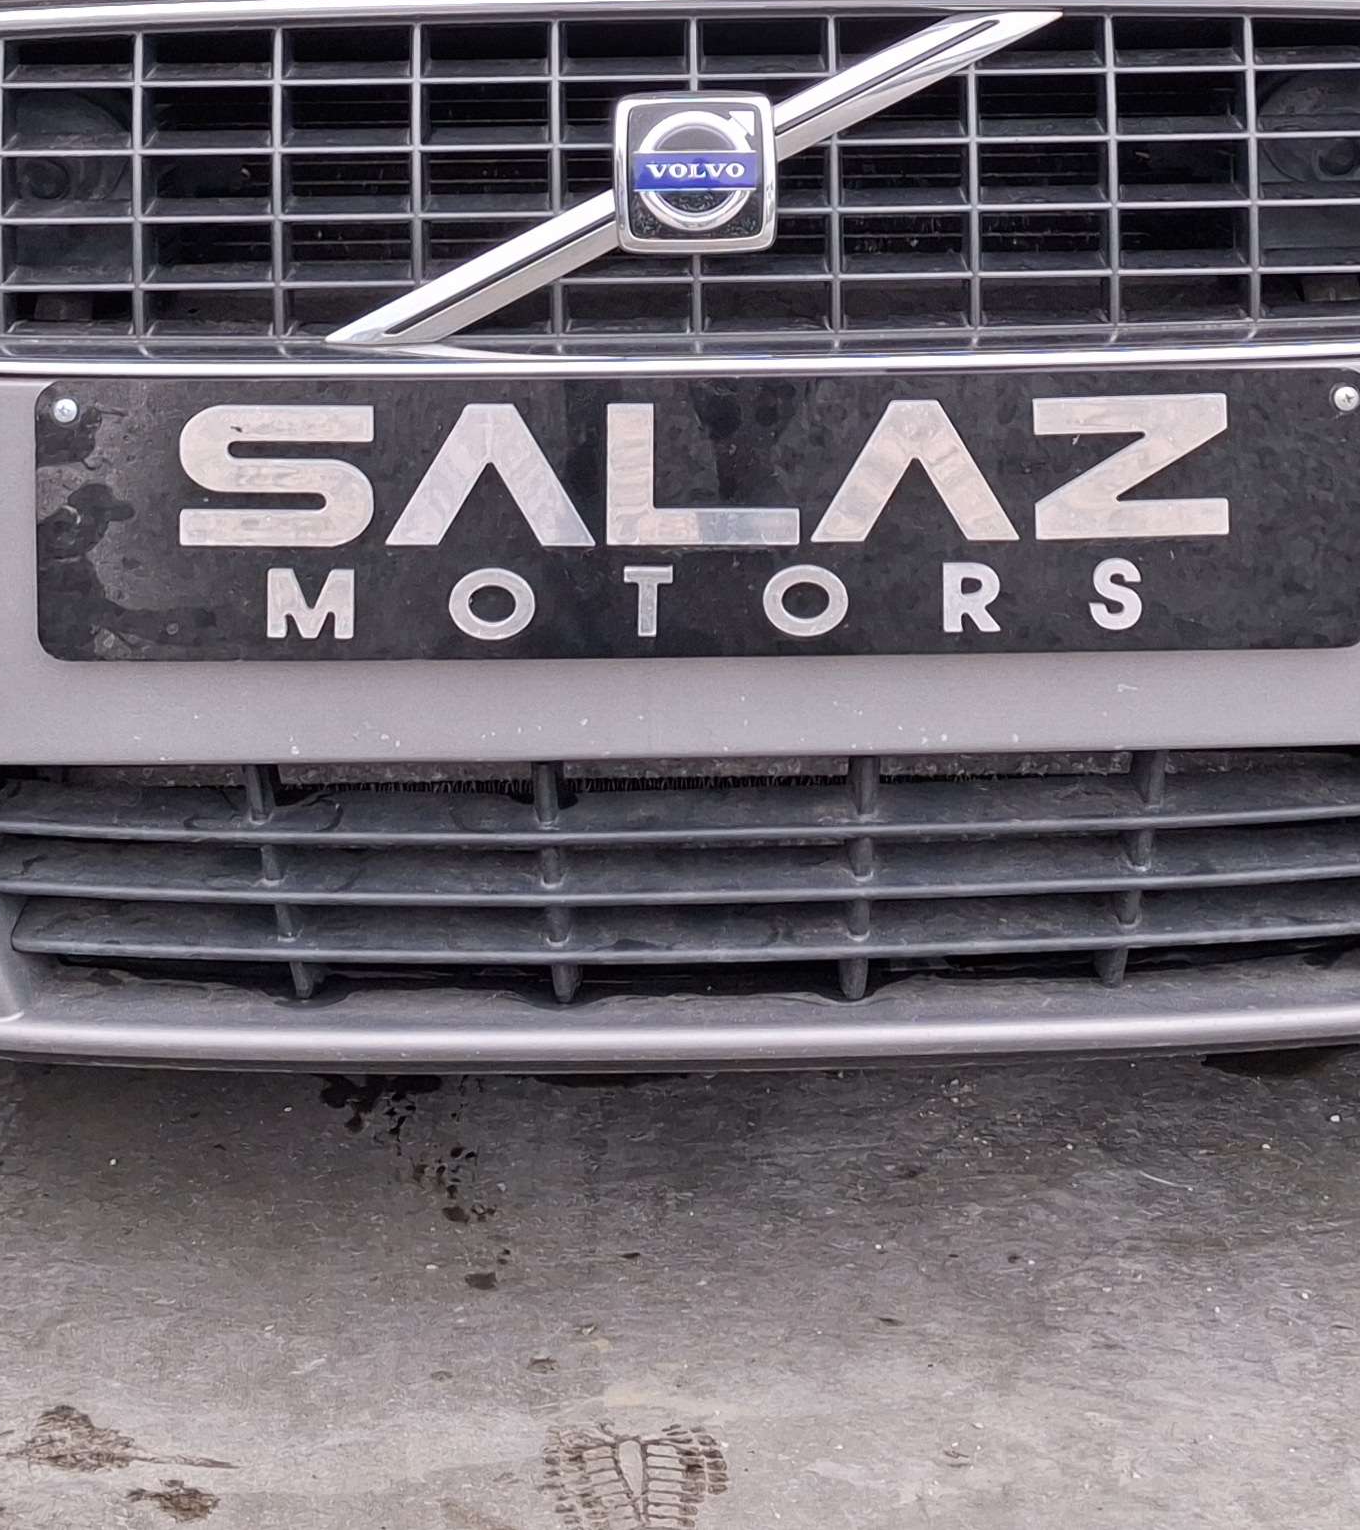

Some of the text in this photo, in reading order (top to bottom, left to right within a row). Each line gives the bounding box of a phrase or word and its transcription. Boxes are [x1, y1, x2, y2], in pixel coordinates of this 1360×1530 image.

[646, 162, 745, 179] VOLVO
[178, 392, 1230, 547] SALAZ
[267, 557, 1143, 641] MOTORS
